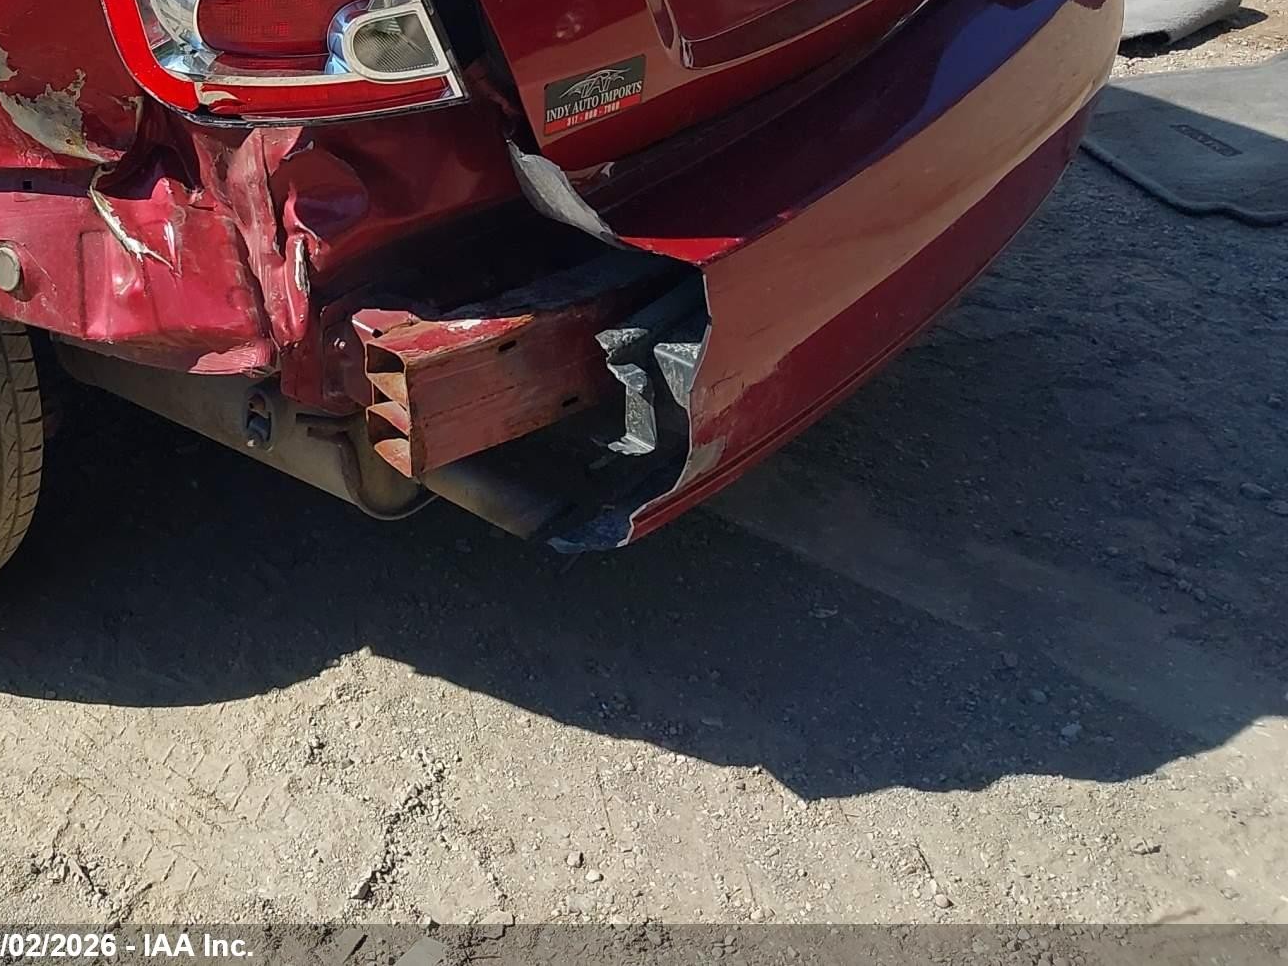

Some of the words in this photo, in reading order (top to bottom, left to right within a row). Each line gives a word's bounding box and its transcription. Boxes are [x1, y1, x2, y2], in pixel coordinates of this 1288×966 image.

[546, 103, 571, 122] INDY
[572, 95, 599, 114] AUTO
[600, 81, 643, 105] IMPORTS
